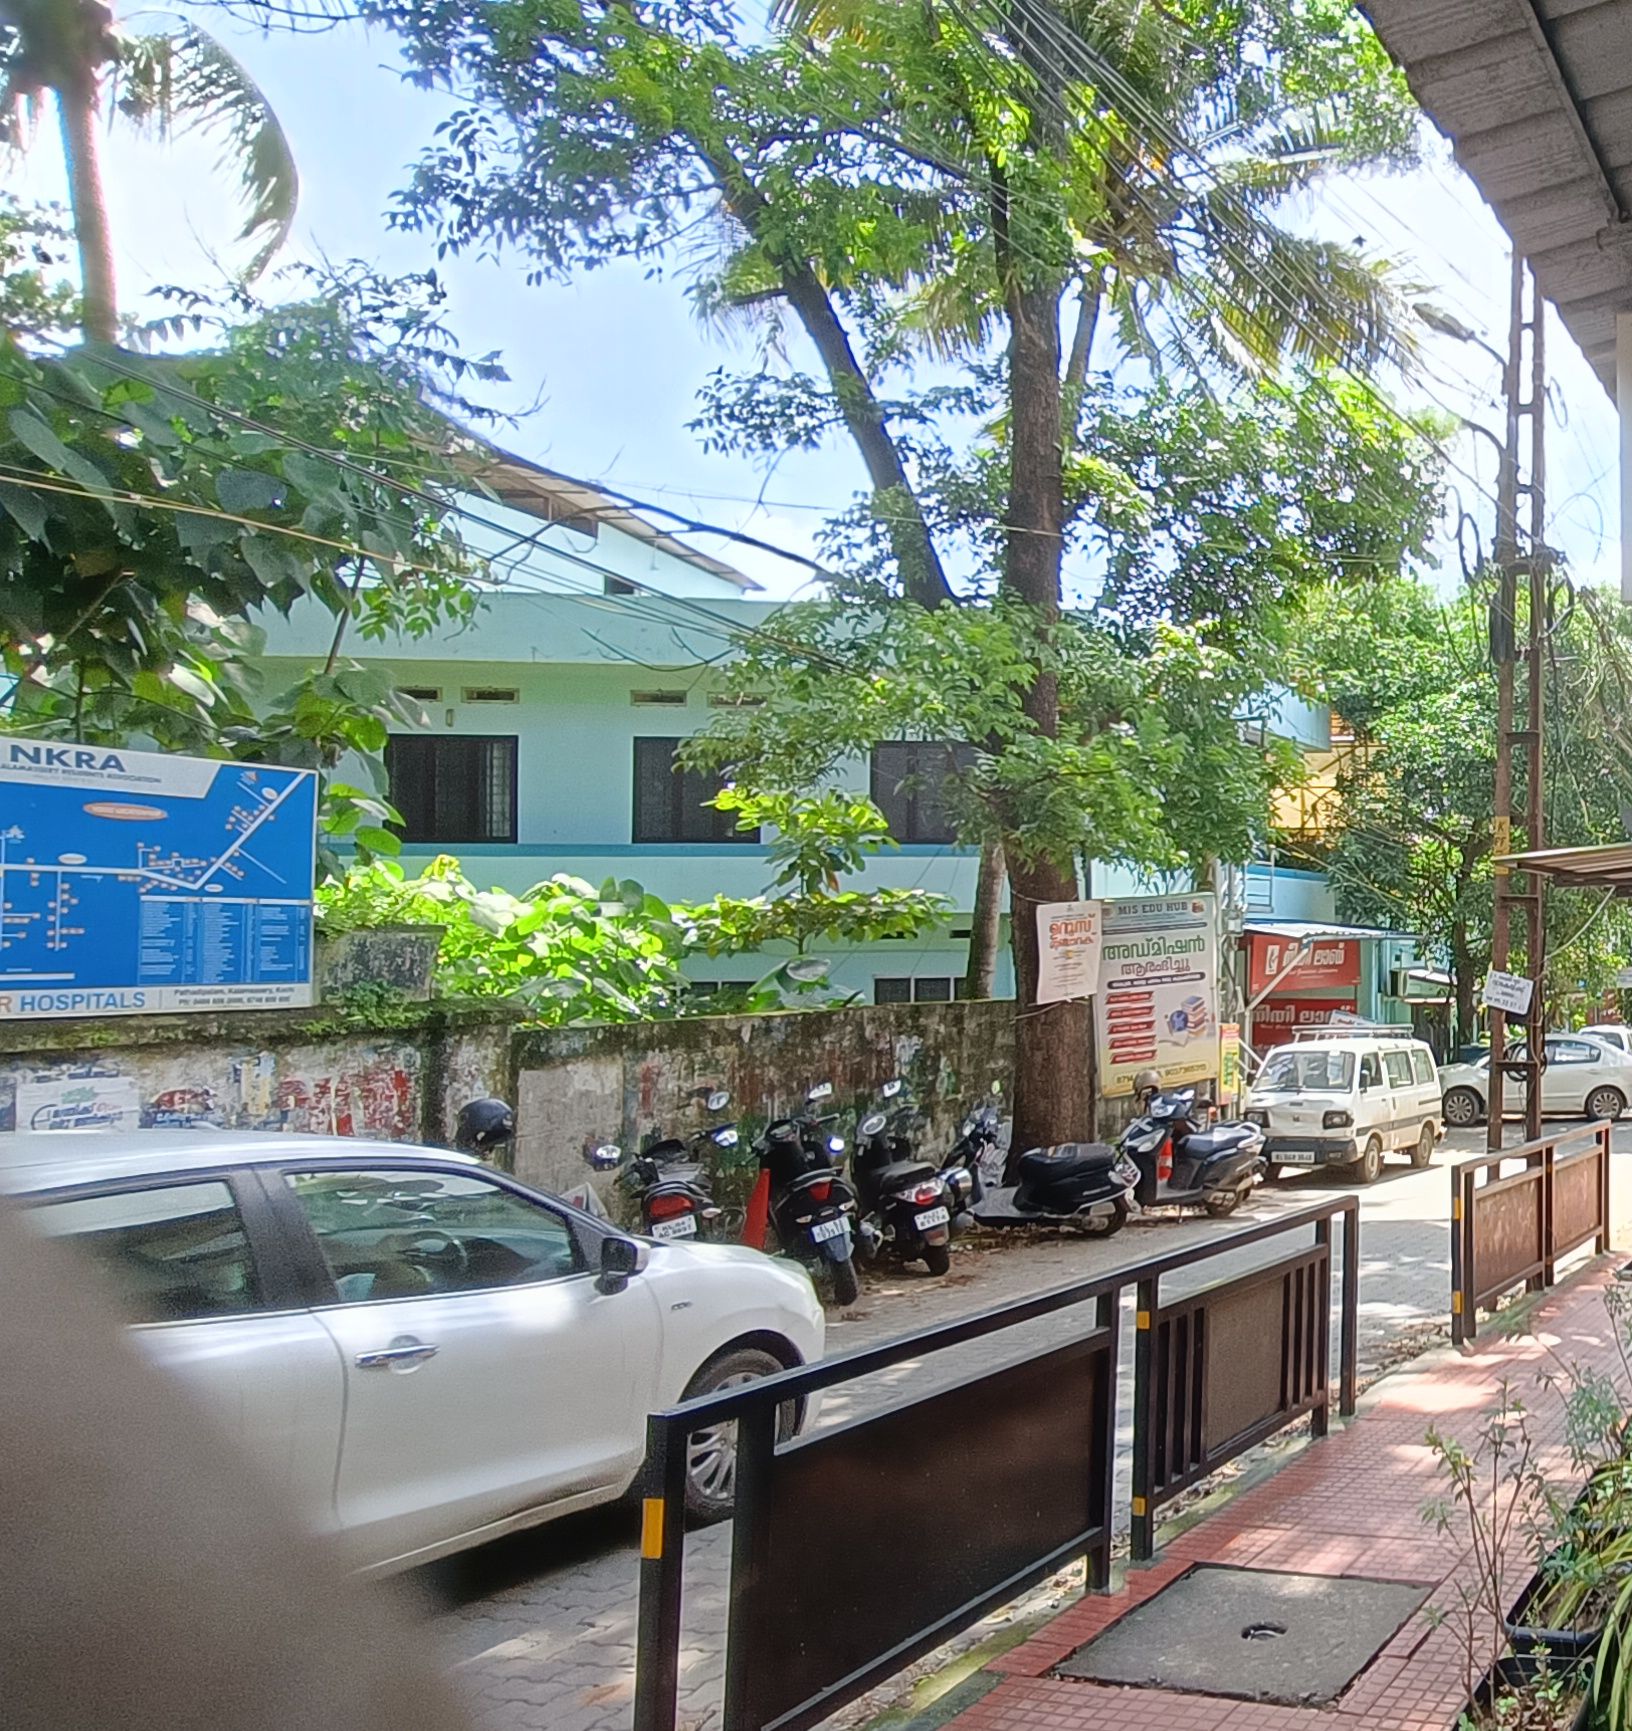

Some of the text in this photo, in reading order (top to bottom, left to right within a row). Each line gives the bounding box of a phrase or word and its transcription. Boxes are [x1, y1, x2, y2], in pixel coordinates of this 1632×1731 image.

[10, 744, 126, 772] NKRA
[1118, 901, 1188, 915] MIS EDU HUB
[20, 991, 146, 1012] HOSPITALS
